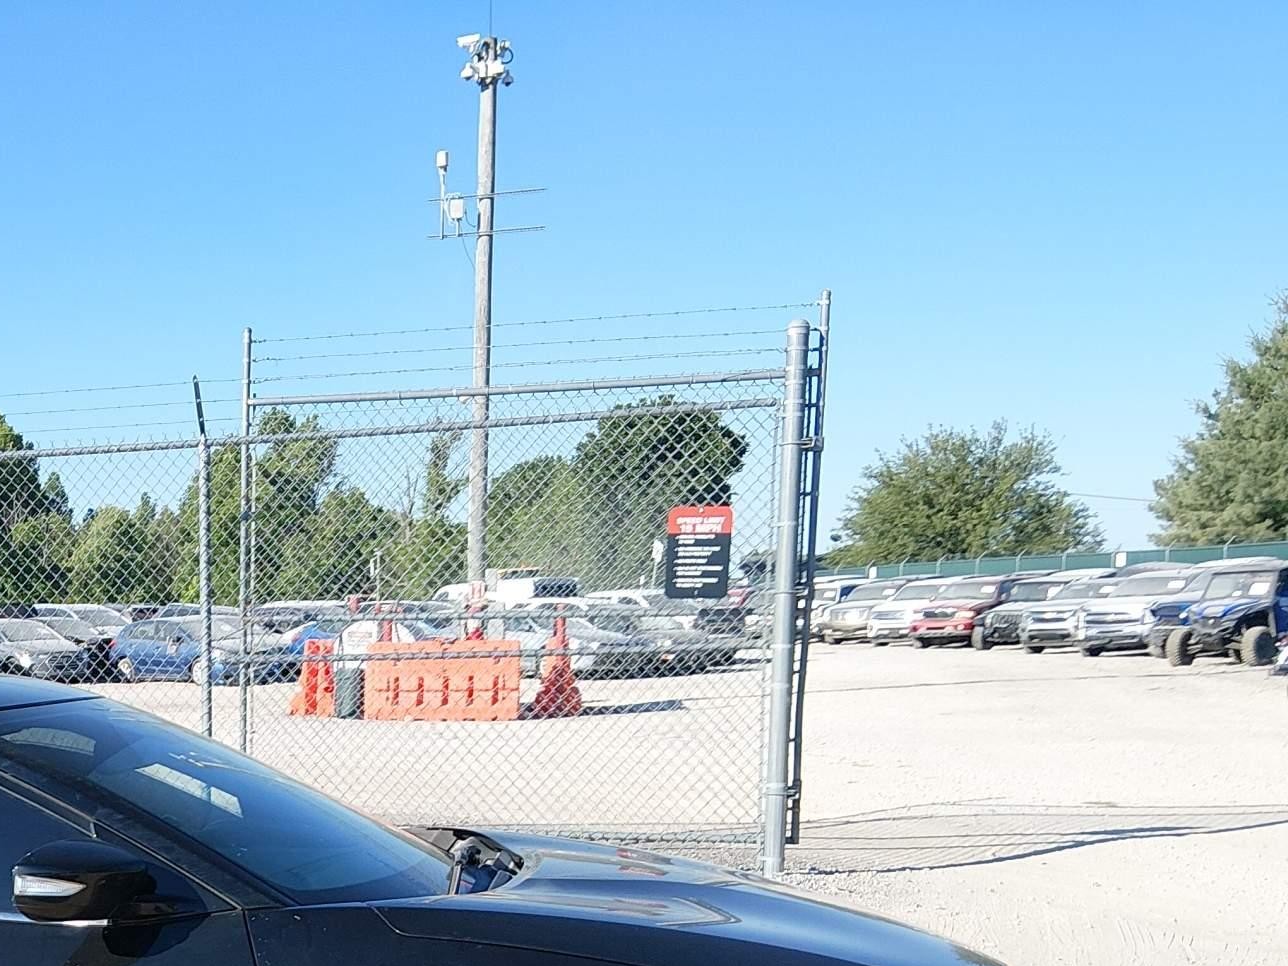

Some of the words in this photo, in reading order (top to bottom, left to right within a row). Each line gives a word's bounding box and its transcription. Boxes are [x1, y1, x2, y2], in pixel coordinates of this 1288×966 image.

[677, 516, 703, 525] SPEED
[704, 516, 726, 524] LIMIT
[680, 524, 693, 533] 15
[695, 524, 722, 533] MPH
